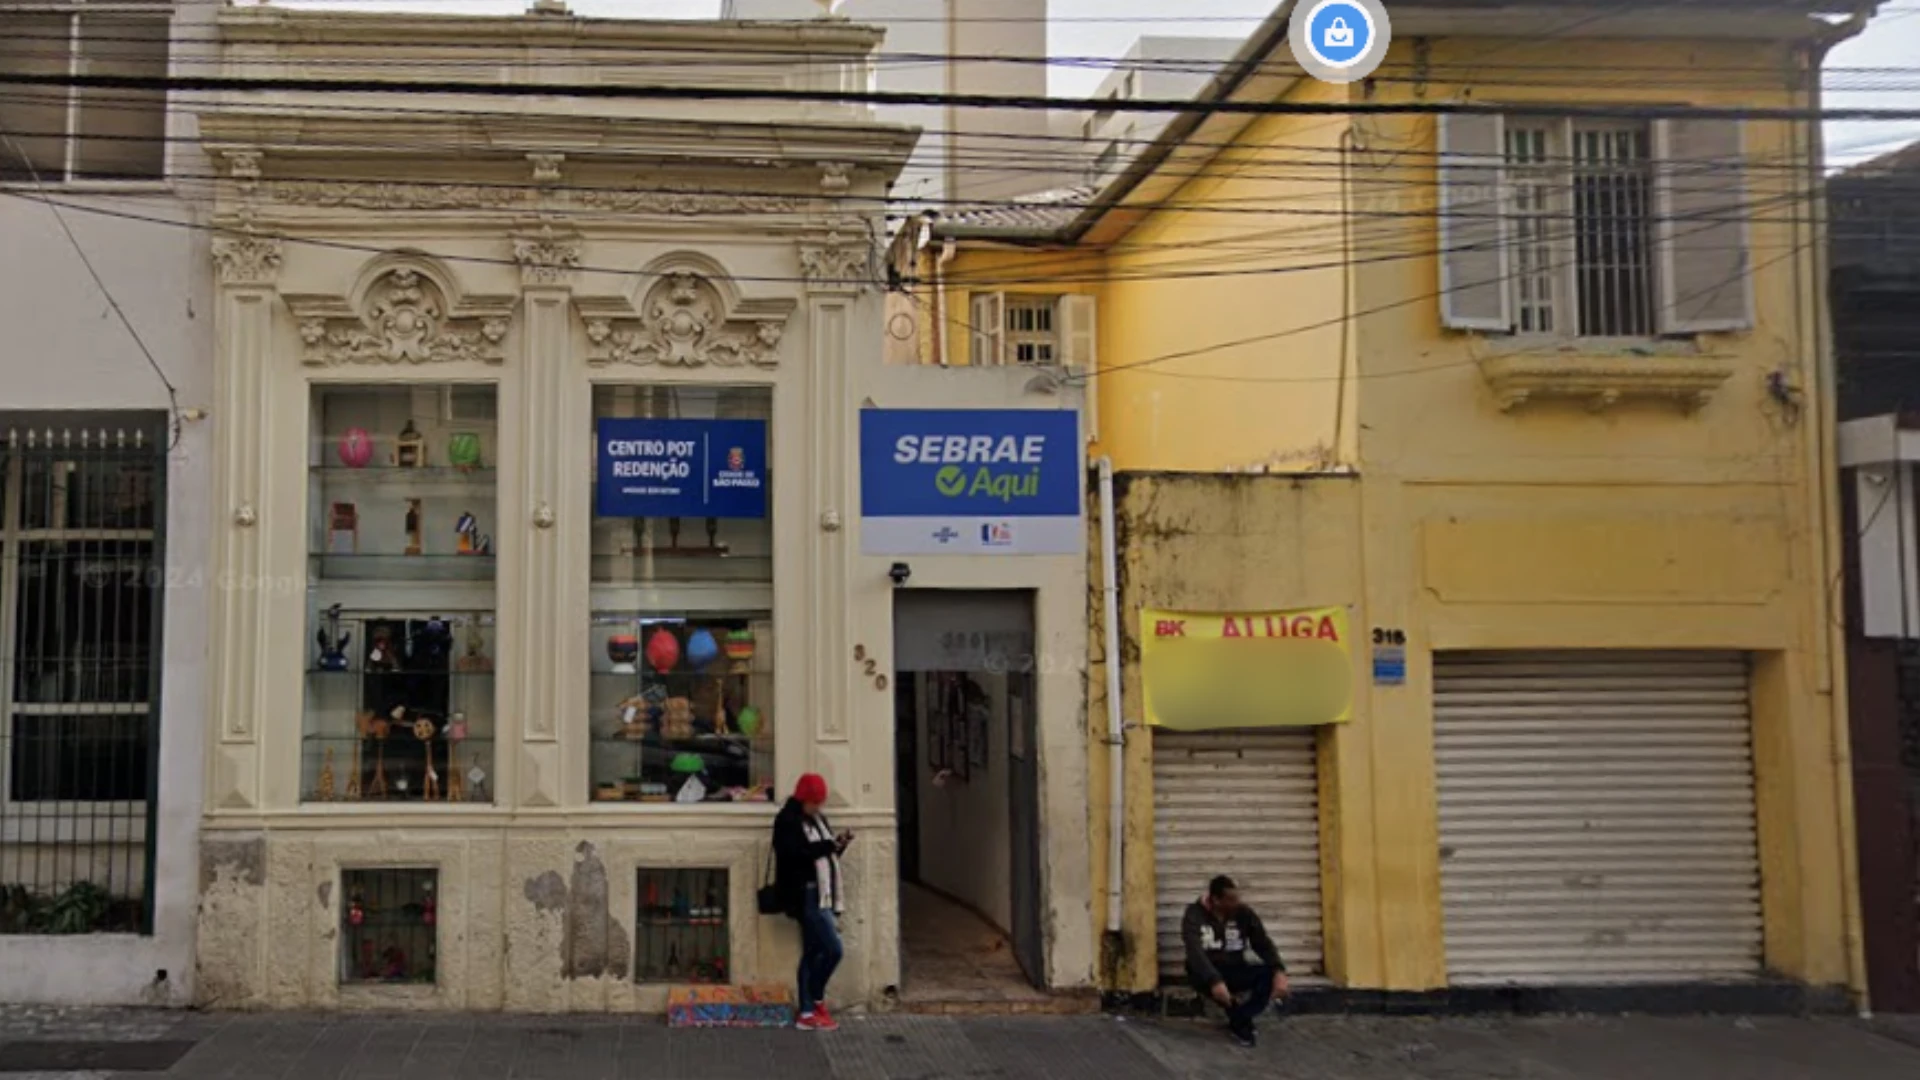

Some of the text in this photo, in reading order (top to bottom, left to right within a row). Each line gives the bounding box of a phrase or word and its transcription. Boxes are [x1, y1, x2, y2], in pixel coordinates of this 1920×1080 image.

[607, 440, 696, 456] CENTRO POT
[893, 434, 1045, 464] SEBRAE
[613, 458, 690, 480] REDENÇÃO
[967, 466, 1040, 503] Aqui
[1154, 620, 1186, 637] BK
